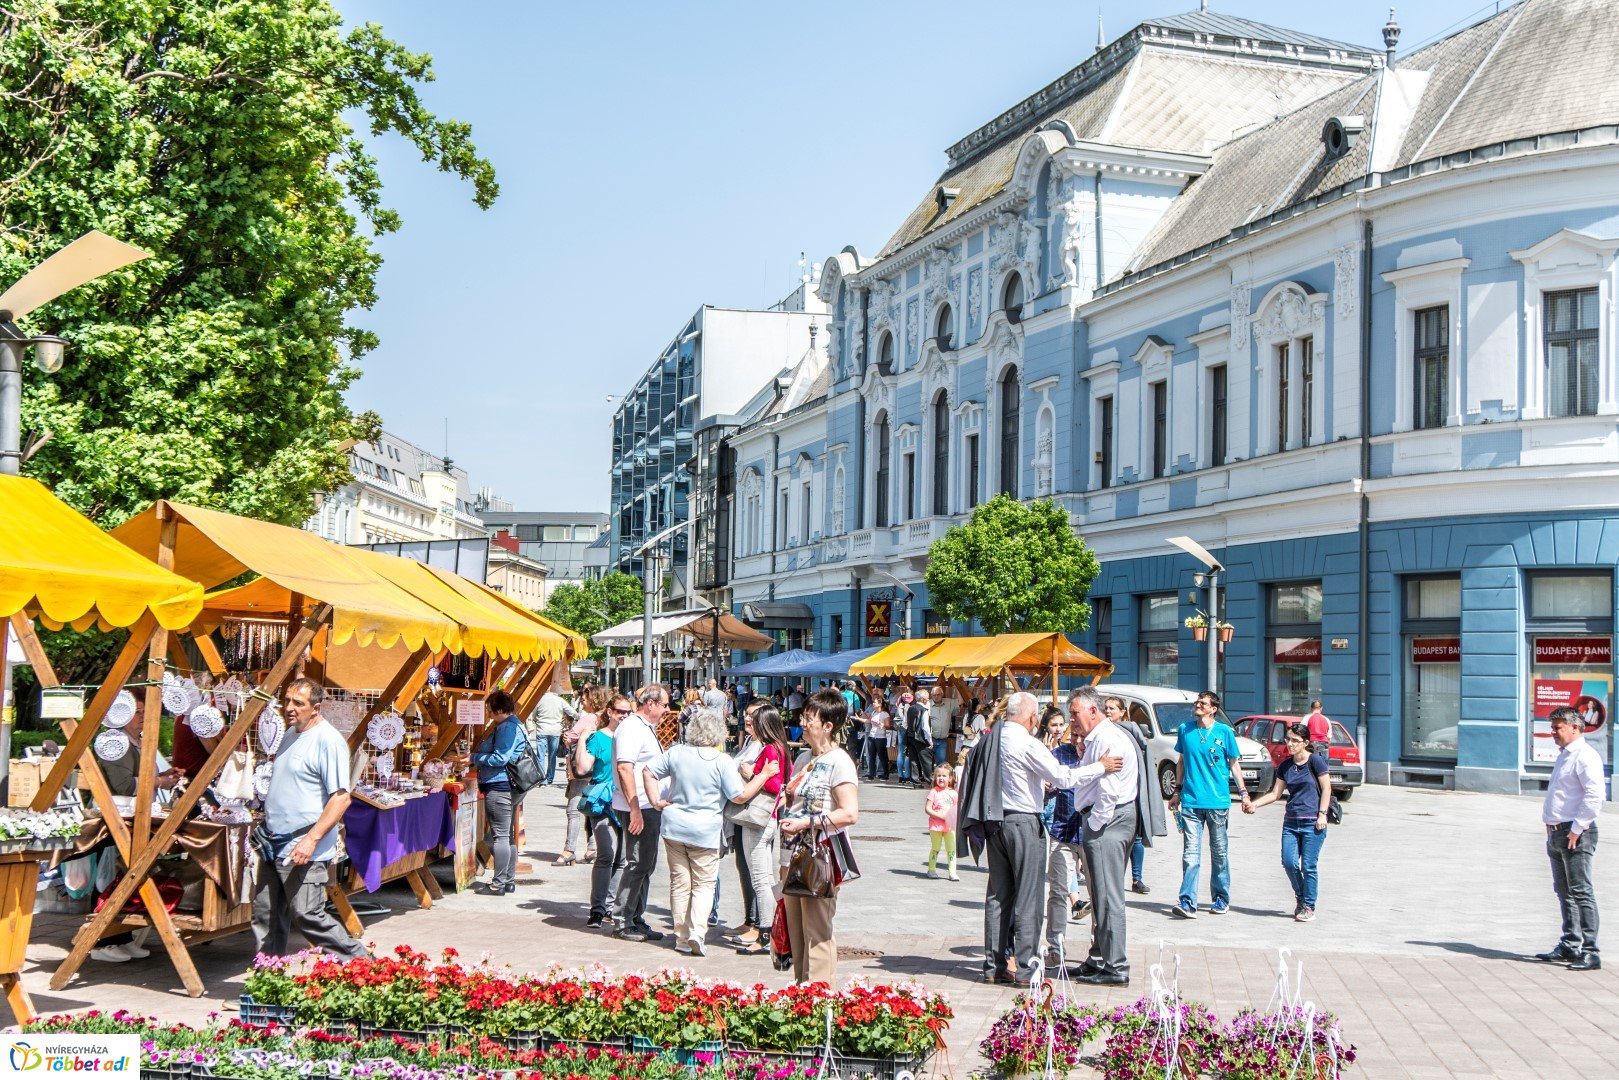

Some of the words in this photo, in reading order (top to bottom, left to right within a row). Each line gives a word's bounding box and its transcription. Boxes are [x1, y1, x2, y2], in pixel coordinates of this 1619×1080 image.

[869, 604, 887, 624] X
[868, 624, 888, 632] CAFÉ
[1306, 648, 1318, 656] BANK
[1413, 647, 1447, 655] BUDAPEST
[1537, 646, 1582, 655] BUDAPEST
[1584, 646, 1611, 655] BANK
